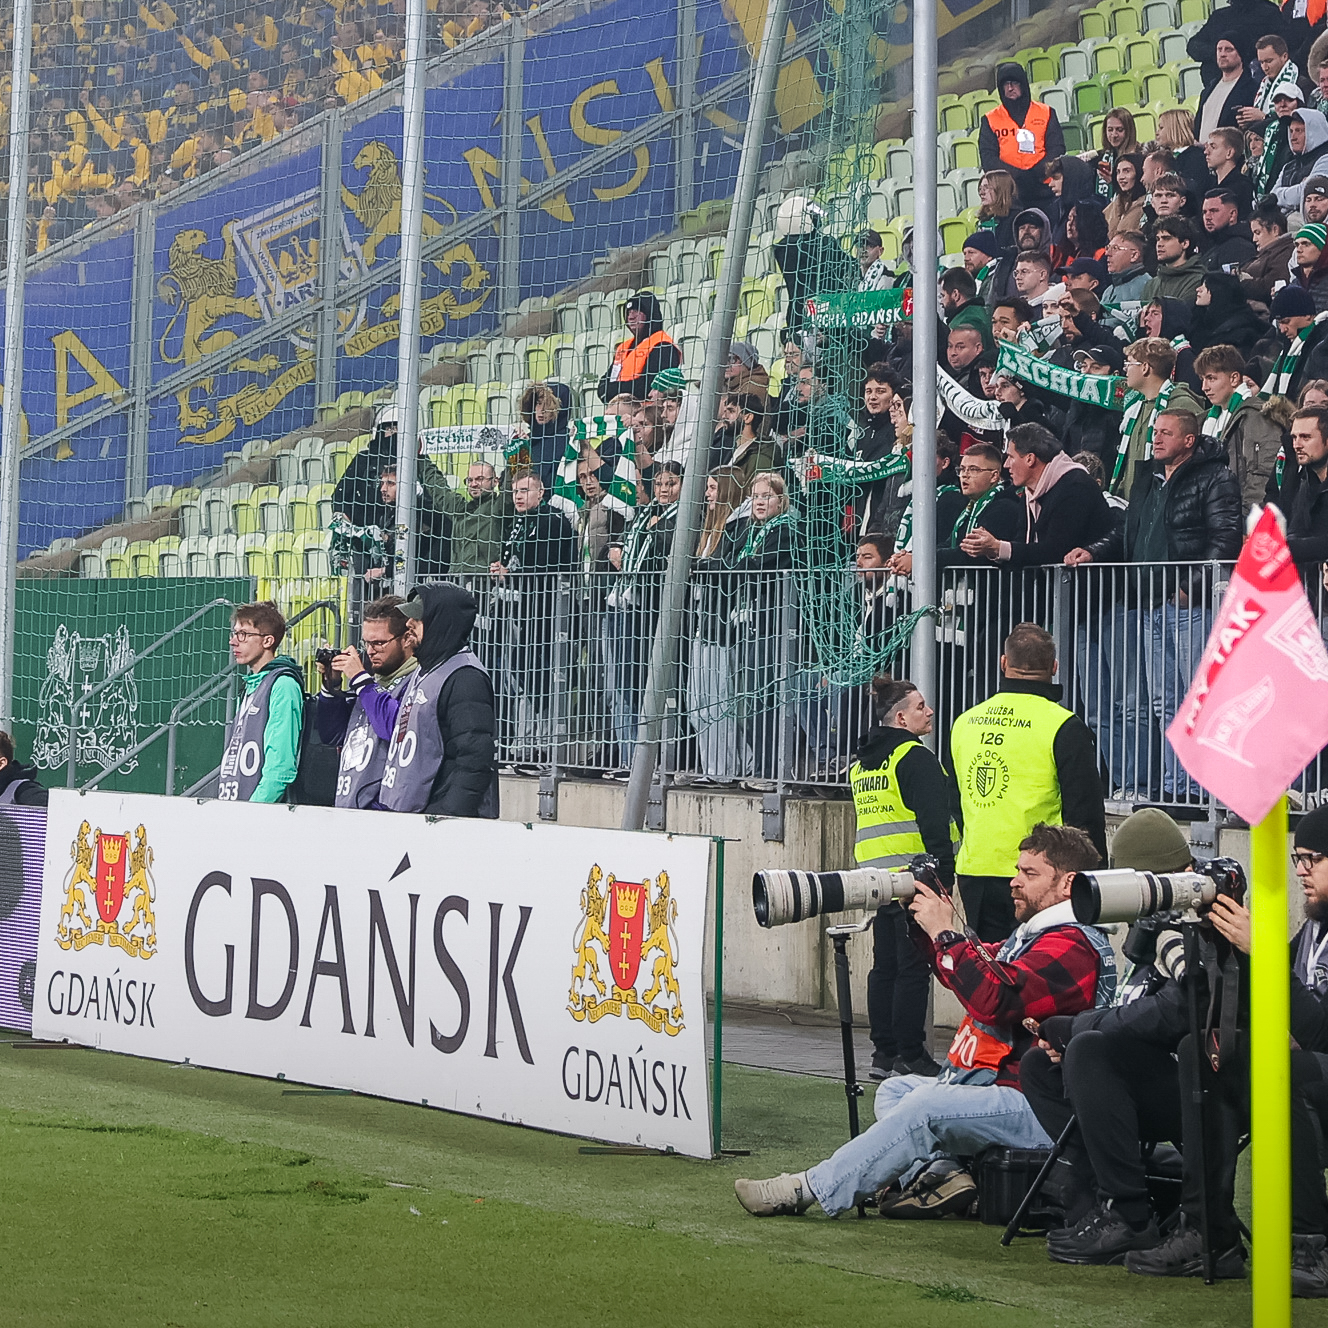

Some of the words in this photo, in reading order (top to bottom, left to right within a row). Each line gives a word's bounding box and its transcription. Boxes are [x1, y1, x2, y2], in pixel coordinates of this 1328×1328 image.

[1001, 349, 1103, 404] LECHIA
[968, 717, 1032, 729] INFORMACYJNA
[986, 706, 1014, 716] SŁUŻBA
[980, 732, 1005, 746] 126
[218, 782, 239, 801] 253
[184, 852, 535, 1066] GDAŃSK
[47, 968, 156, 1029] GDAŃSK
[562, 1045, 692, 1120] GDAŃSK
